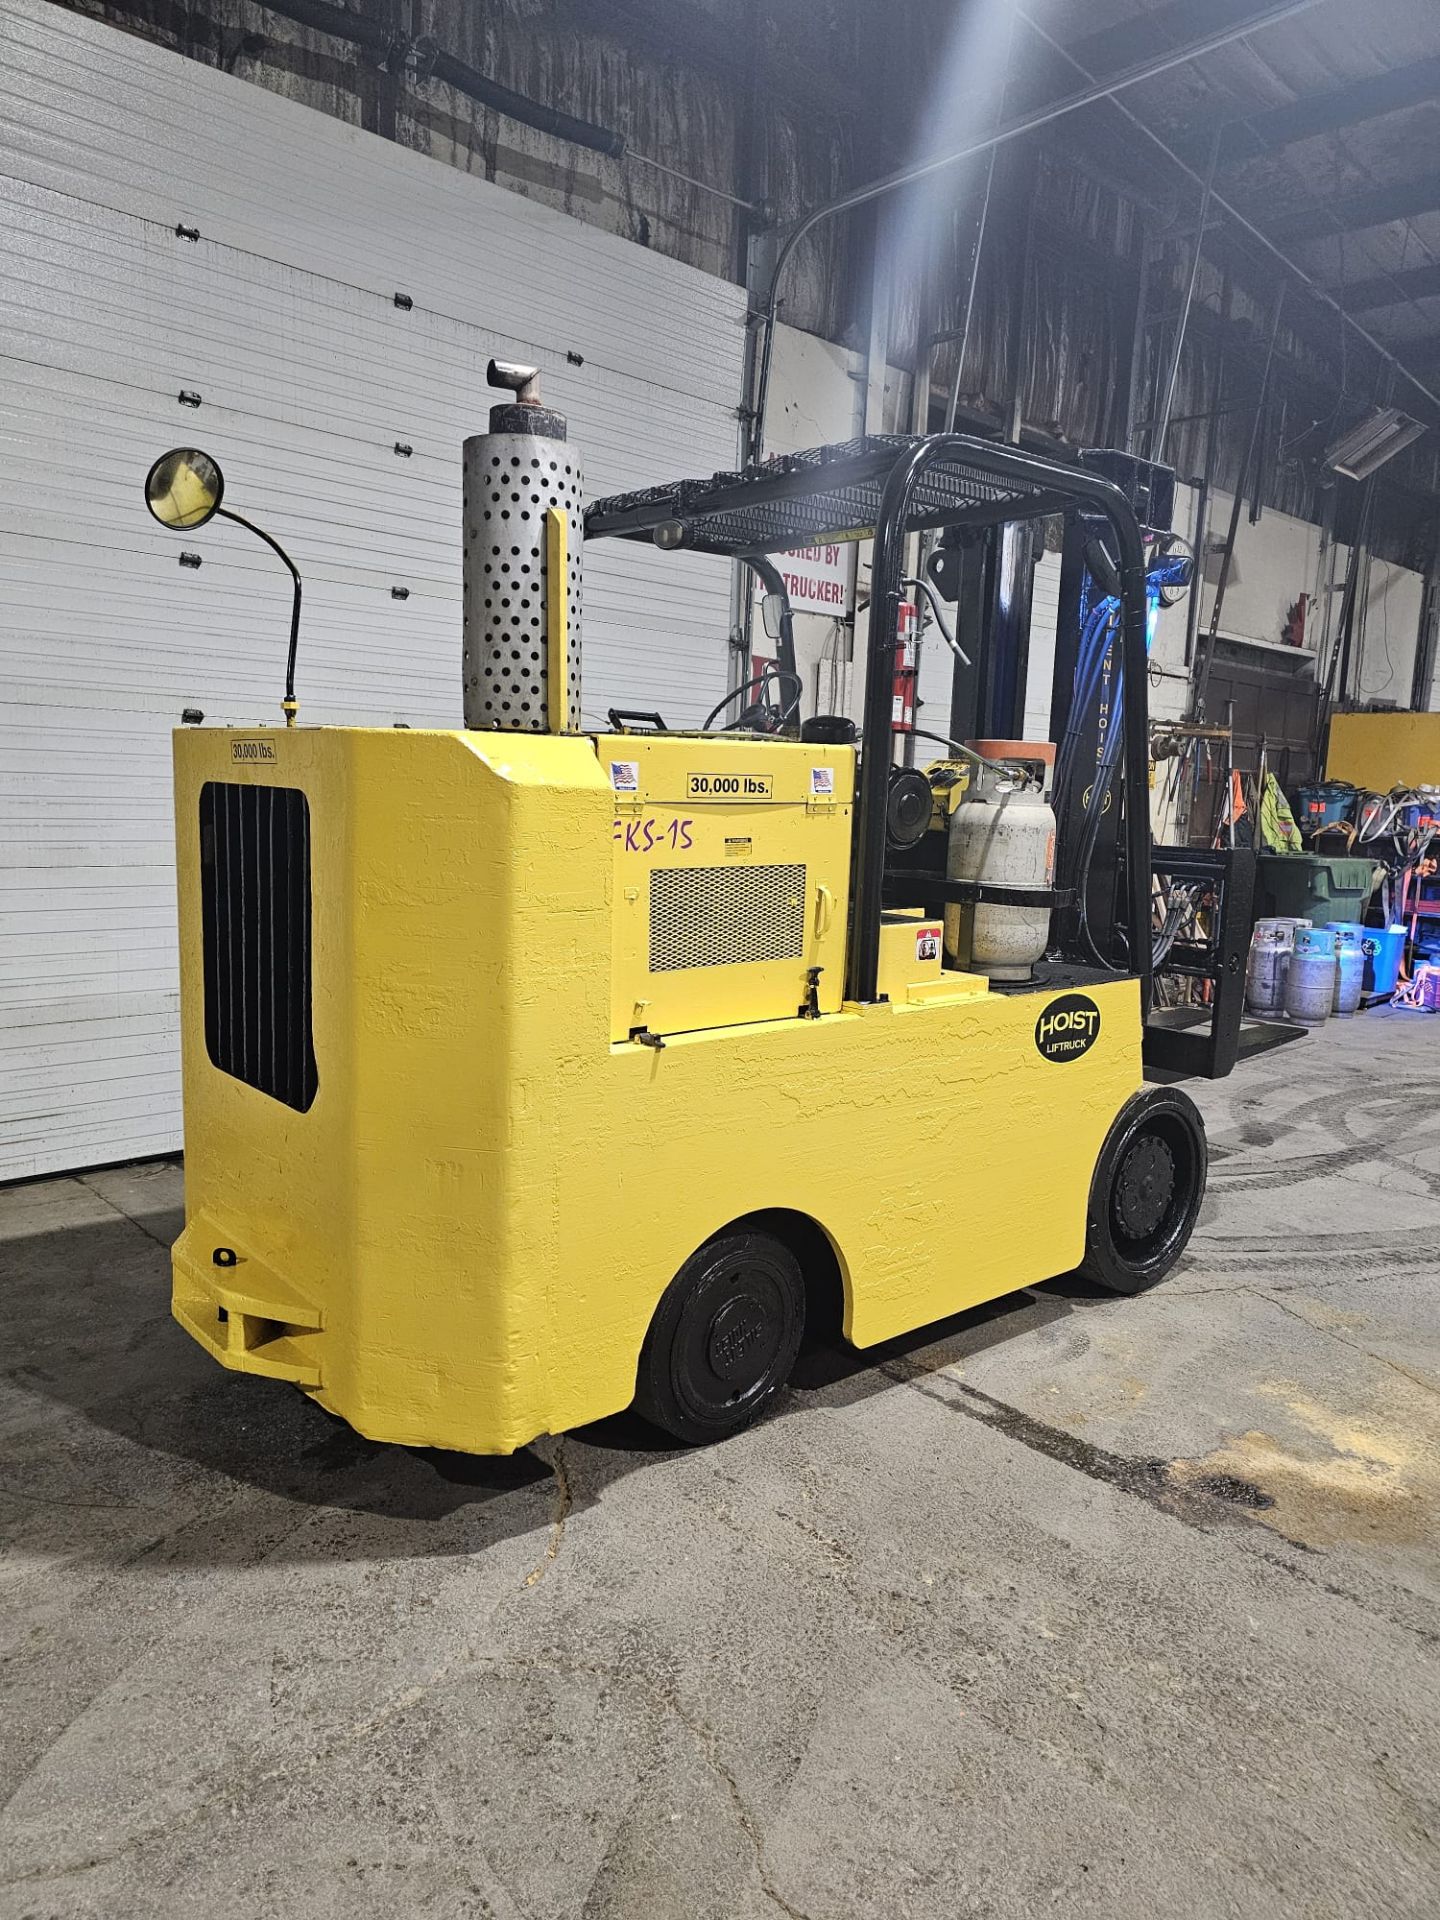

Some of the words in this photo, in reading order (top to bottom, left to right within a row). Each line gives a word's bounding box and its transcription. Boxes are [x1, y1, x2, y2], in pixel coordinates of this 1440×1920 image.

[825, 544, 840, 566] BY
[782, 572, 844, 605] TRUCKER!
[1096, 703, 1109, 765] HOIS
[233, 744, 257, 760] 30,000
[258, 743, 274, 758] lbs.
[690, 777, 739, 796] 30,000
[743, 778, 769, 794] lbs.
[1039, 1011, 1098, 1043] HOIST
[1046, 1038, 1086, 1053] LIFTRUCK
